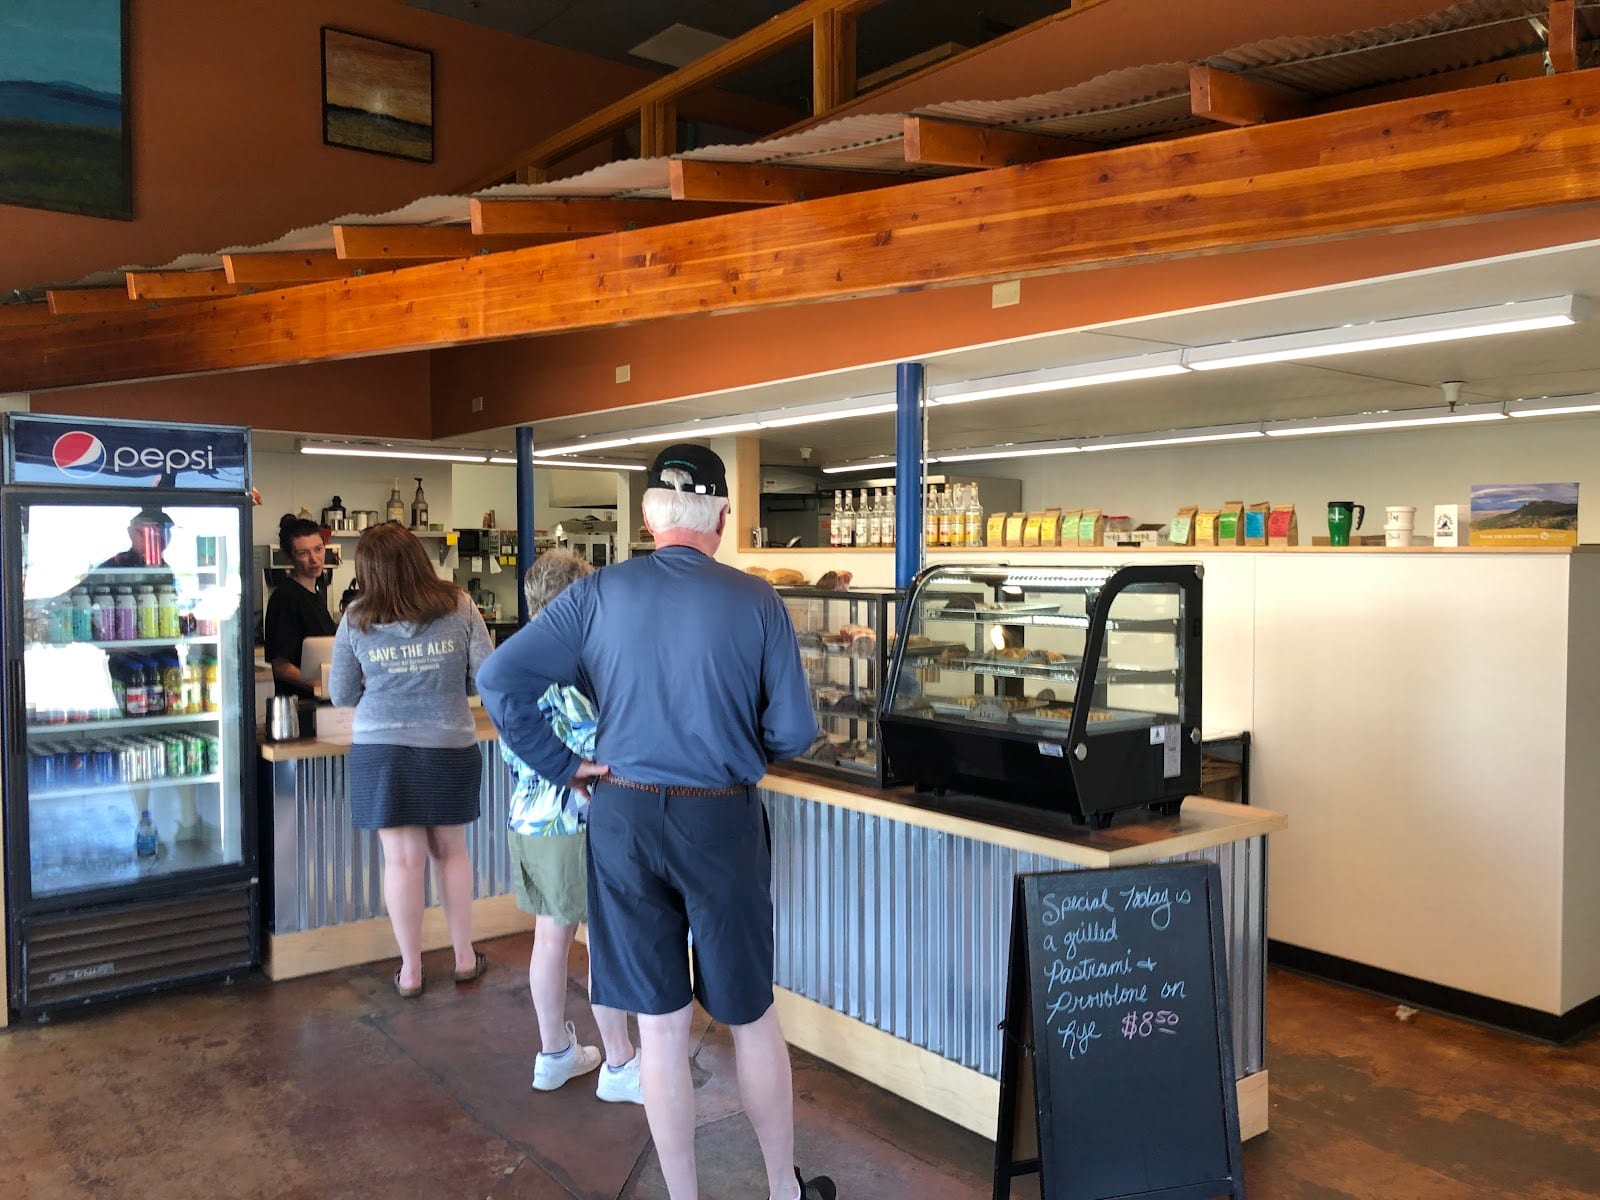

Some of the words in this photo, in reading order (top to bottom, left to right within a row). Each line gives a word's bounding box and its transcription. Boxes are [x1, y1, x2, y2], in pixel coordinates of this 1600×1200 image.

[114, 445, 213, 474] pepsi
[368, 646, 398, 662] SAVE
[400, 643, 423, 658] THE
[427, 640, 455, 655] ALES
[1042, 888, 1114, 926] Special
[1119, 885, 1172, 931] Today
[1176, 888, 1192, 905] is
[1043, 935, 1057, 952] a
[1064, 917, 1118, 960] grilled
[1044, 949, 1132, 993] Pastrami
[1046, 983, 1147, 1024] Provolone
[1160, 980, 1187, 1000] on
[1058, 1018, 1103, 1060] Rye
